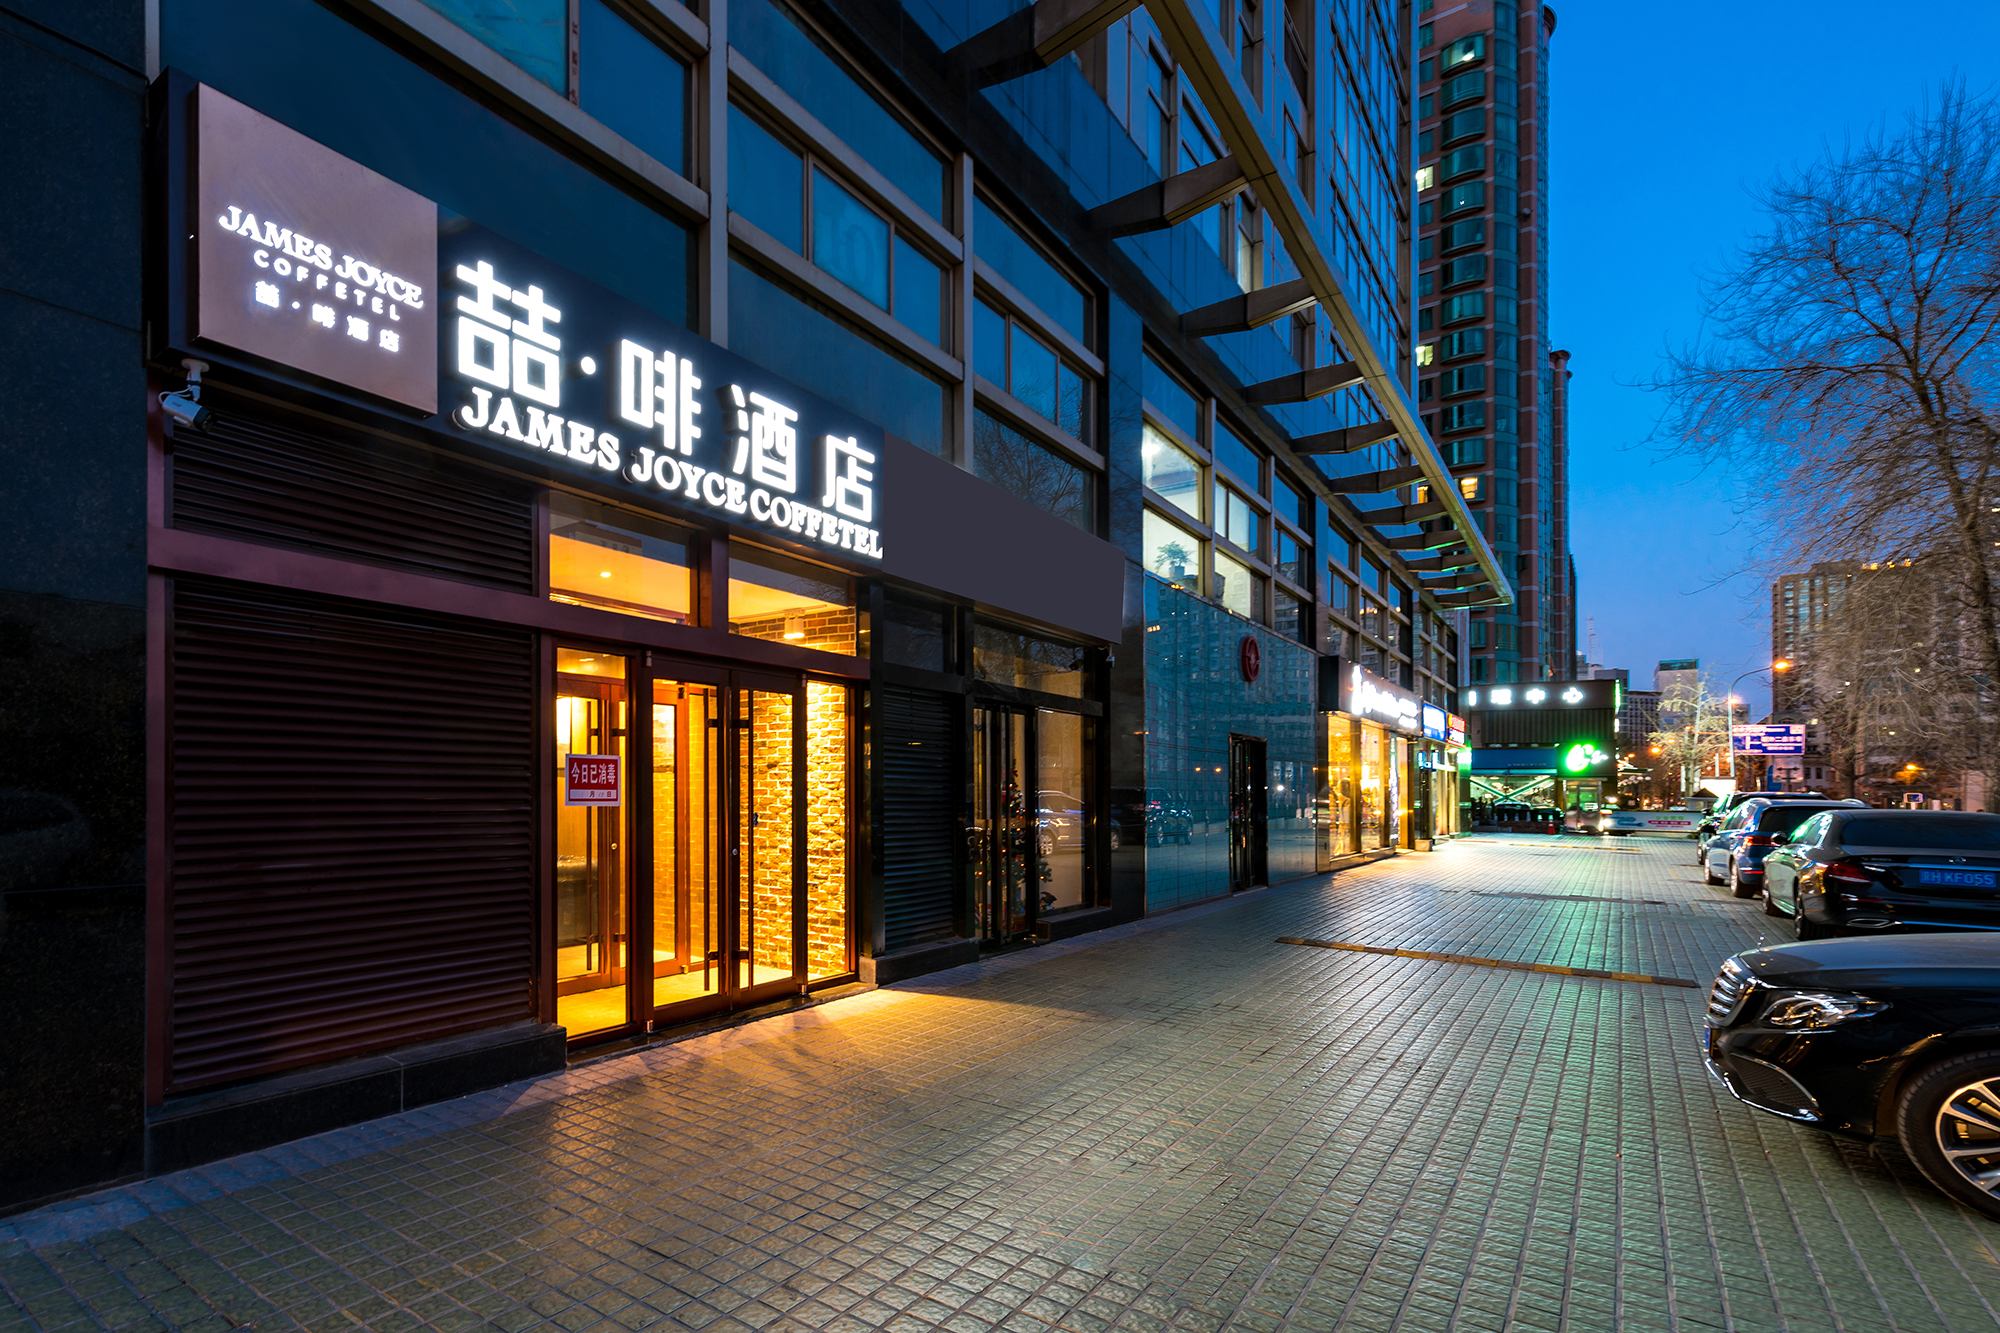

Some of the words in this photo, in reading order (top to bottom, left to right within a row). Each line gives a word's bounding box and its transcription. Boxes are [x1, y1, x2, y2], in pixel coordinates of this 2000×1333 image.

[218, 205, 332, 270] JAMES
[335, 254, 424, 309] JOYCE
[253, 249, 401, 321] COFFETEL
[461, 387, 620, 471] JAMES
[631, 447, 748, 514] JOYCE
[750, 488, 883, 559] COFFETEL
[571, 762, 616, 785] 今日已消毒
